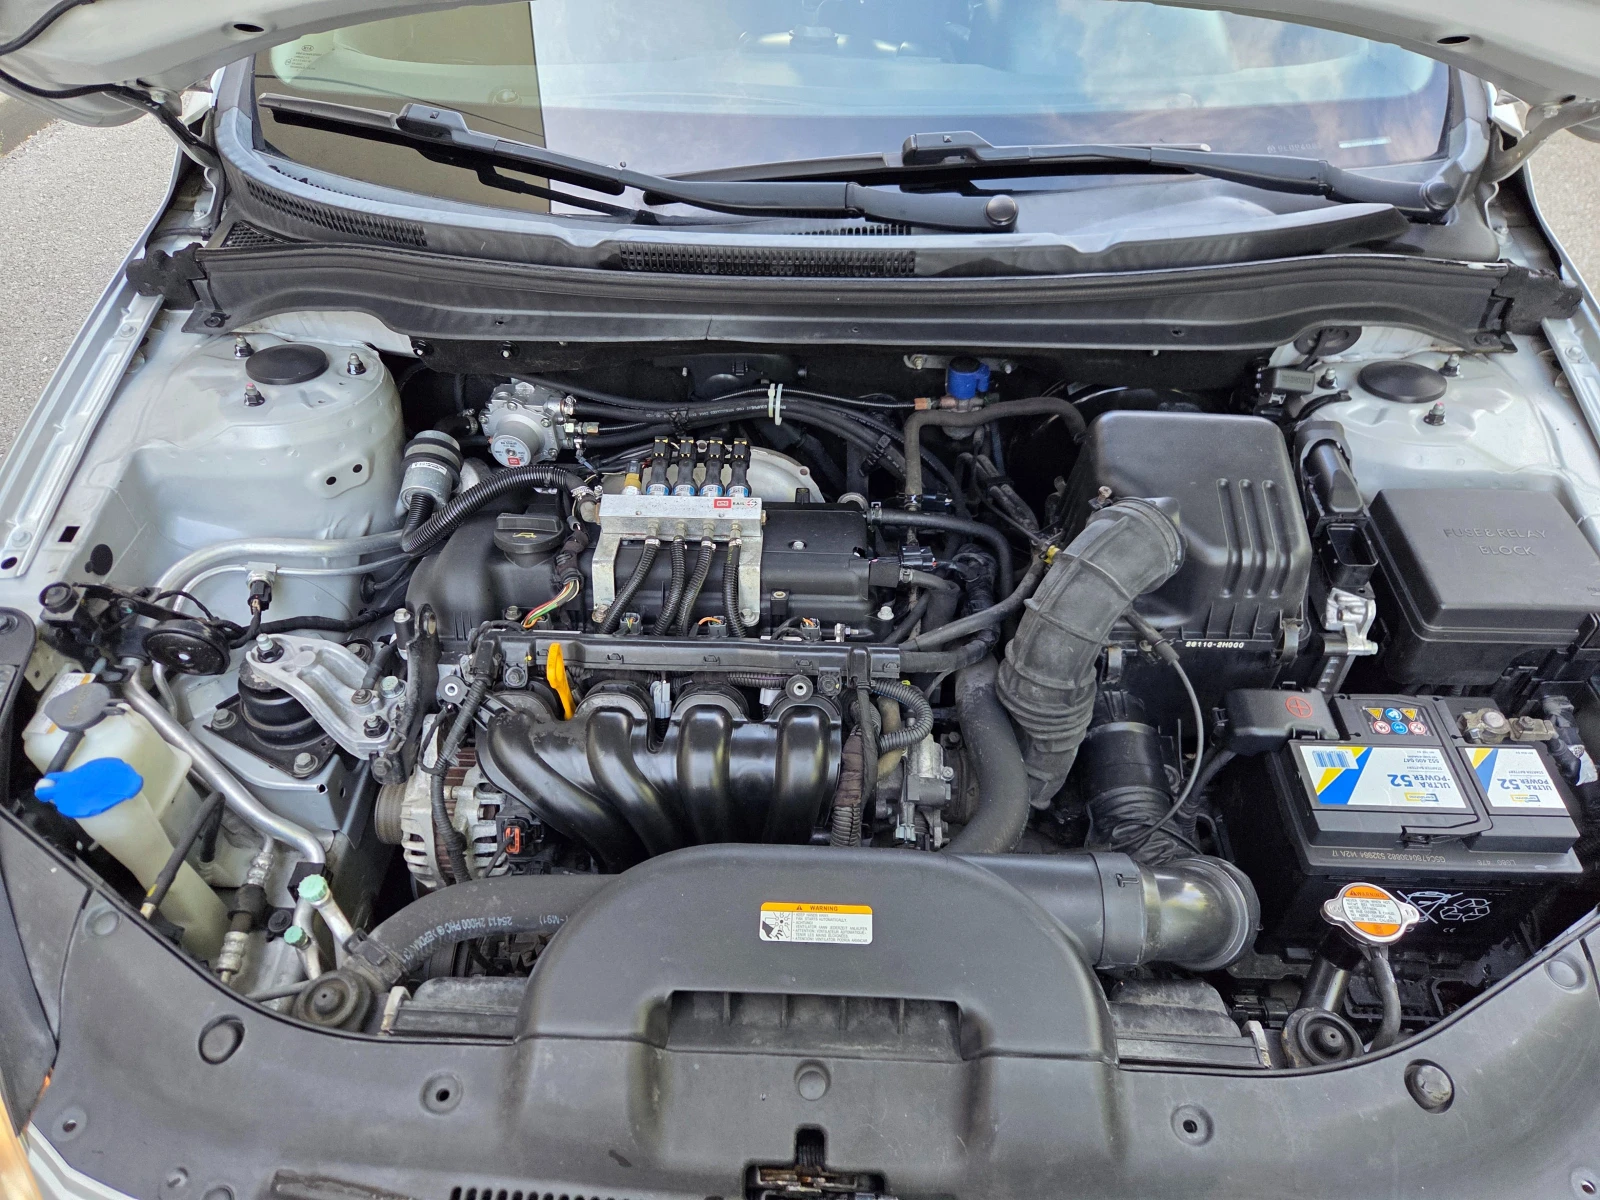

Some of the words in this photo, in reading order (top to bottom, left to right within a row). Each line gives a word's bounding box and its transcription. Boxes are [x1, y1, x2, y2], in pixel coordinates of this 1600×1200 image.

[1442, 528, 1547, 539] FUSE&RELAY
[1478, 545, 1536, 556] BLOCK
[1387, 773, 1413, 788] 52
[1412, 774, 1447, 782] POWER
[1418, 781, 1451, 789] ULTRA
[1496, 778, 1521, 790] 52
